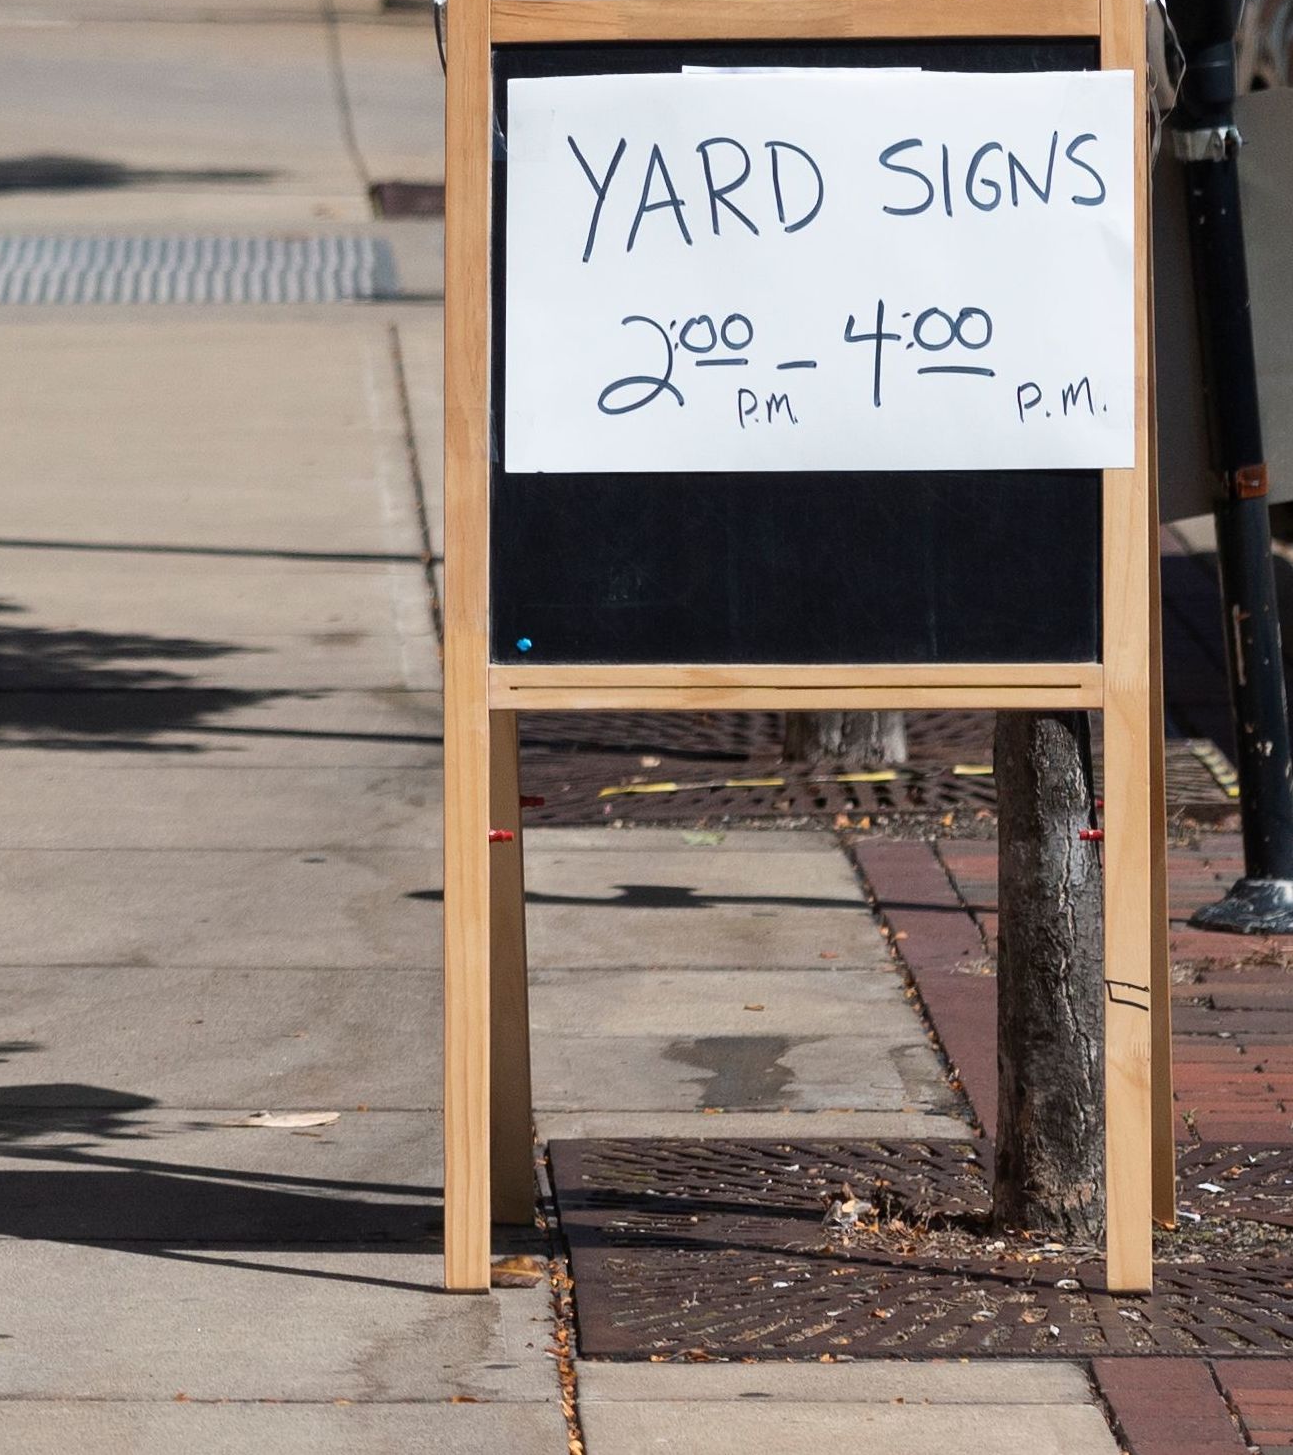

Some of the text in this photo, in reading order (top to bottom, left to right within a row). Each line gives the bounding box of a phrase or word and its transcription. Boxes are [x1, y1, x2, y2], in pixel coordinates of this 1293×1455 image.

[567, 130, 1107, 263] YARD SIGNS
[843, 299, 993, 408] 4:00
